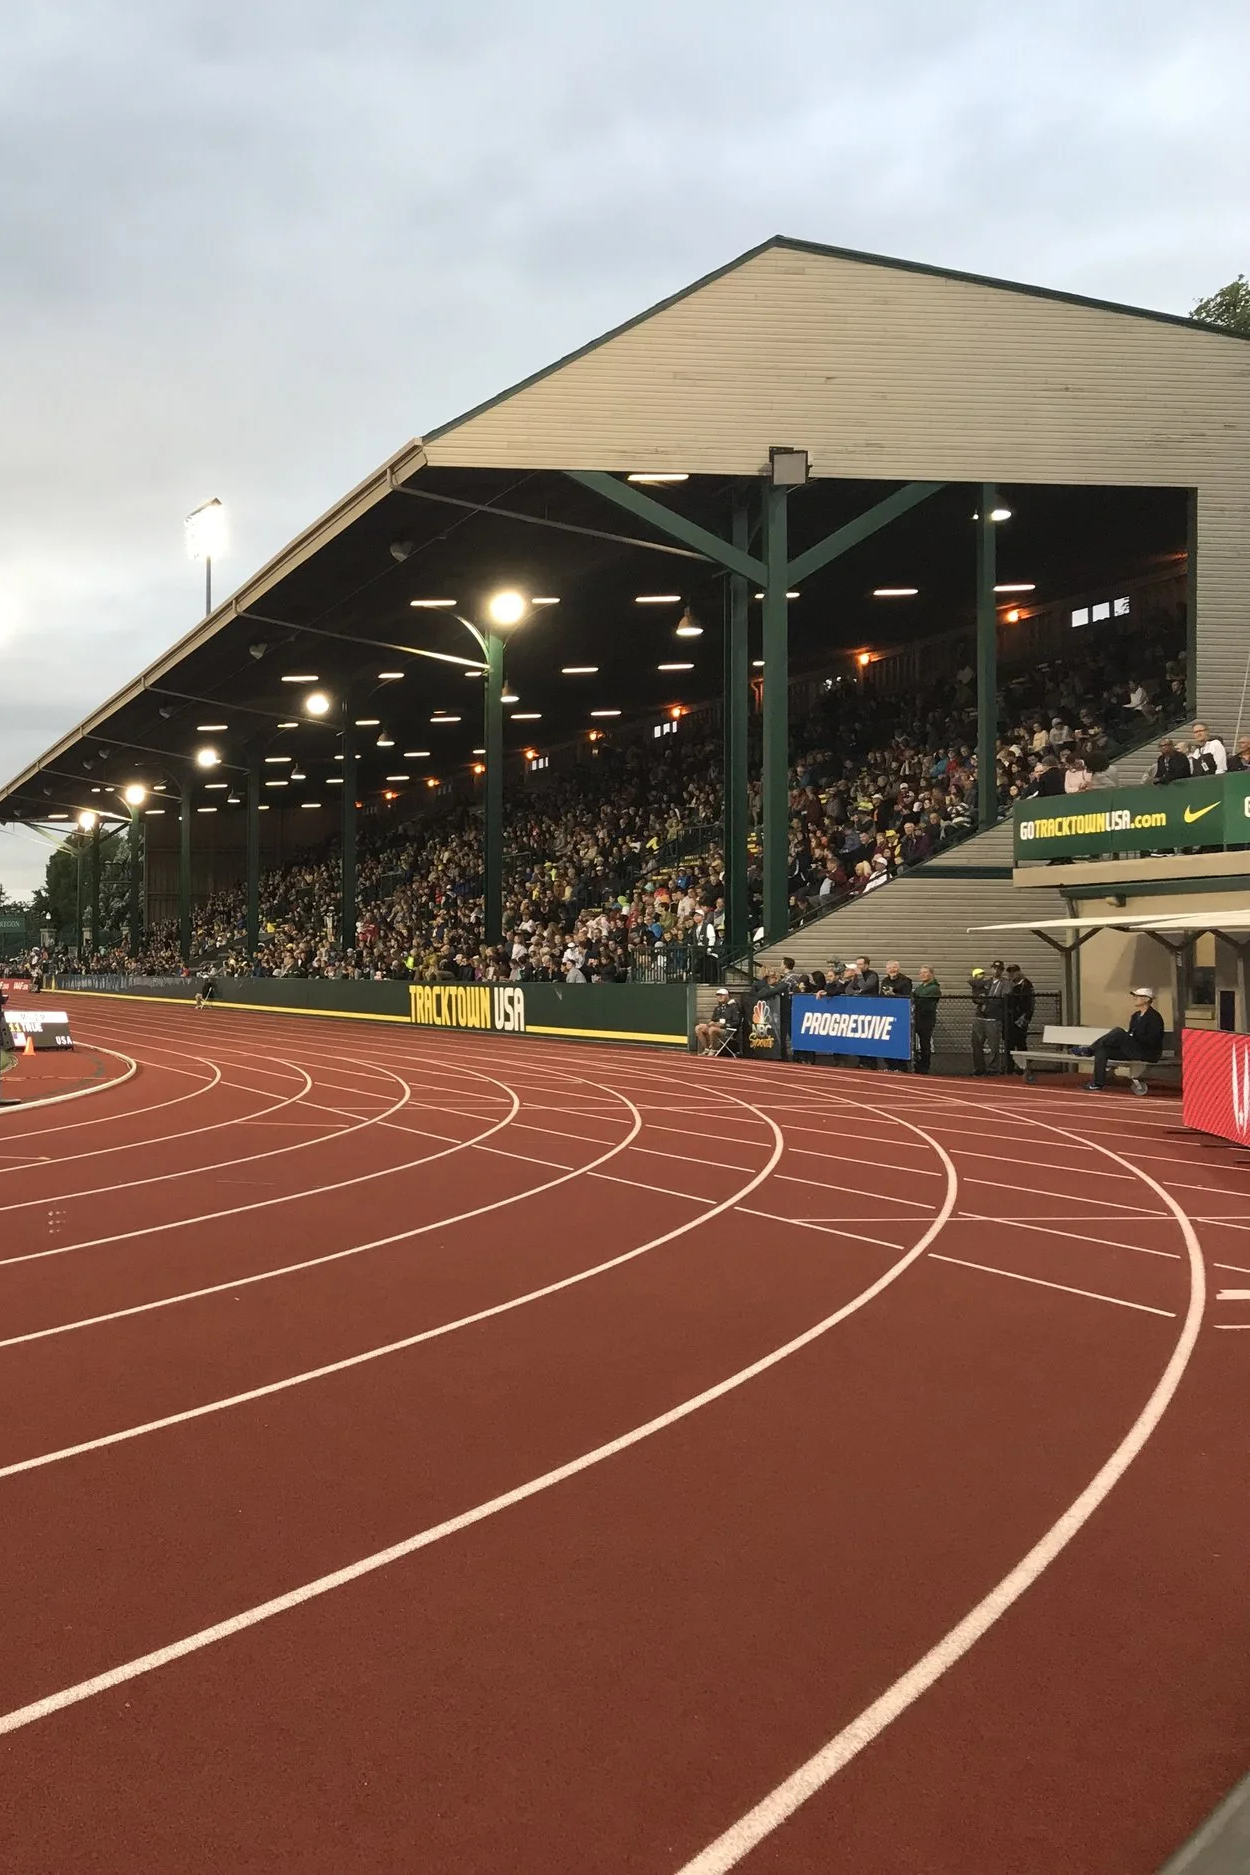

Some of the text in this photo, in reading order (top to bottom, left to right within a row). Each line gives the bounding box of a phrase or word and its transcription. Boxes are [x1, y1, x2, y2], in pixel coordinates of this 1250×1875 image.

[1020, 809, 1167, 840] GOTRACKTOWNUSA.com
[409, 985, 525, 1032] TRACKTOWN USA
[55, 1035, 73, 1045] USA
[751, 1023, 772, 1037] NBC
[801, 1012, 895, 1040] PROGRESSIVE
